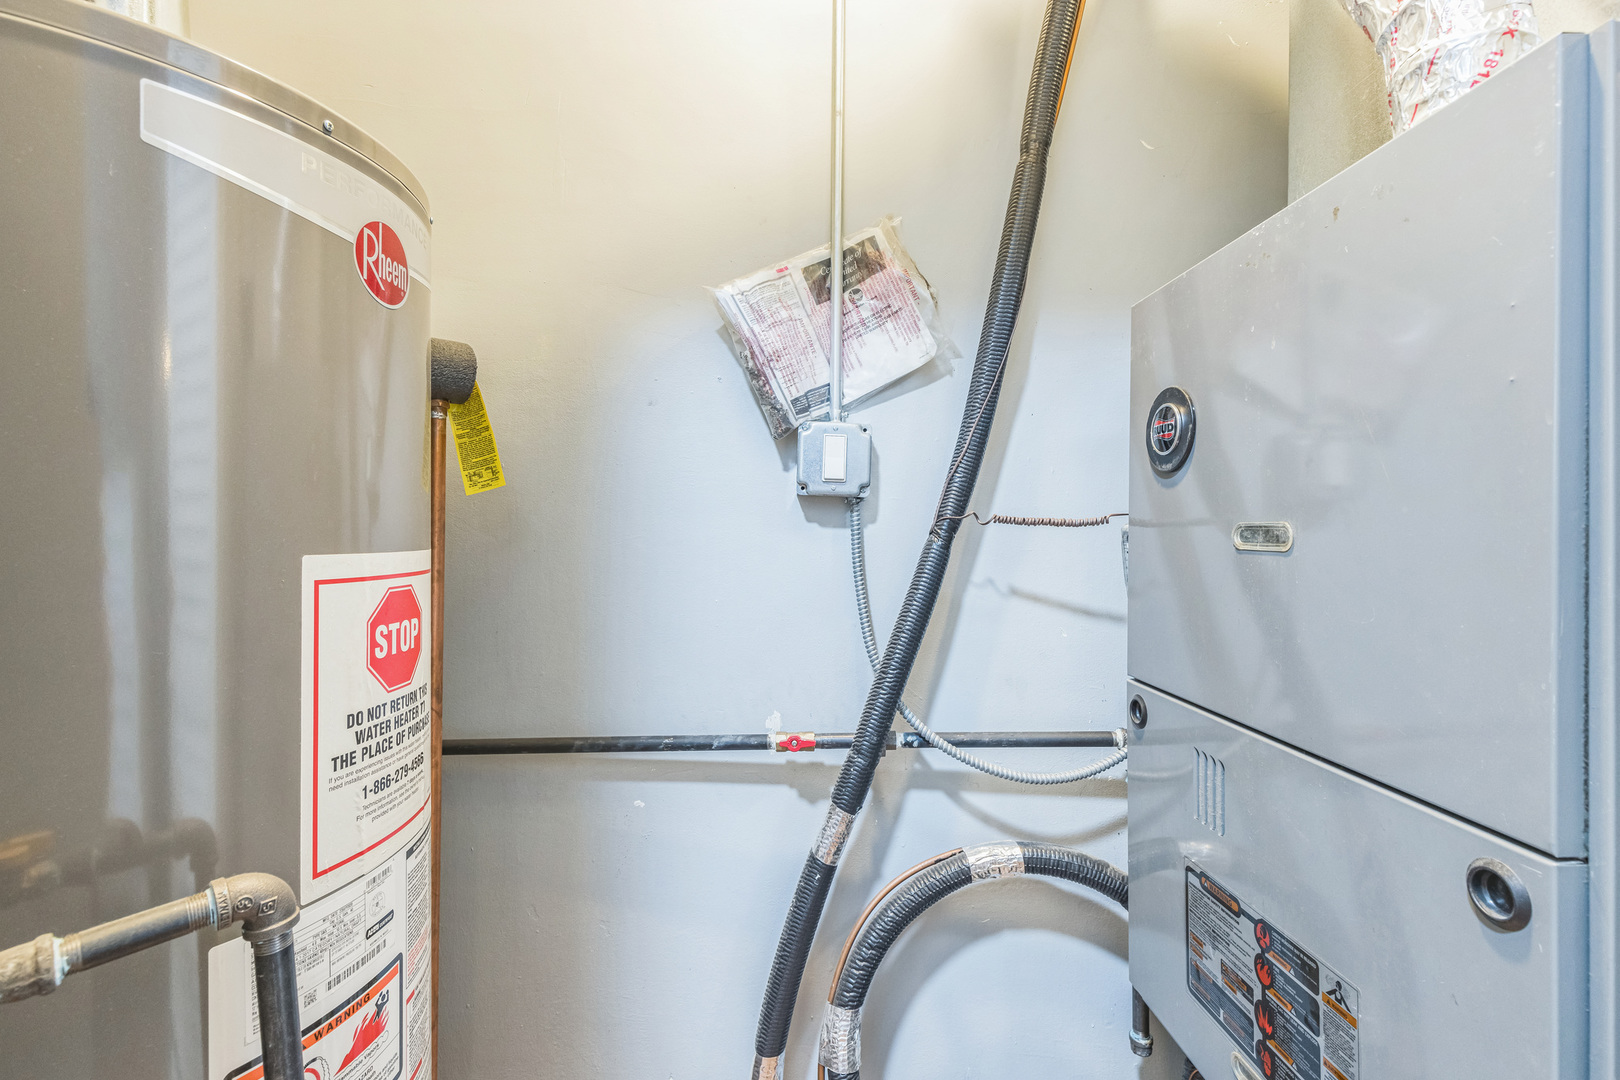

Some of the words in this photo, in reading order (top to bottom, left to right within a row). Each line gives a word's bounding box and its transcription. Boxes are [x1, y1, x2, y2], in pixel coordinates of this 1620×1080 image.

[301, 151, 428, 250] PERFORMANCE
[362, 222, 406, 292] Rheem
[374, 618, 419, 659] STOP
[346, 710, 364, 730] DO
[367, 702, 388, 722] NOT
[390, 689, 418, 714] RETURN
[355, 719, 391, 745] WATER
[394, 705, 419, 730] HEATER
[331, 750, 356, 772] THE
[361, 736, 393, 762] PLACE
[396, 729, 406, 746] OF
[329, 782, 343, 792] need
[344, 772, 370, 786] installation
[356, 814, 364, 822] For
[1209, 882, 1232, 906] WARNING
[314, 993, 371, 1040] WARNING
